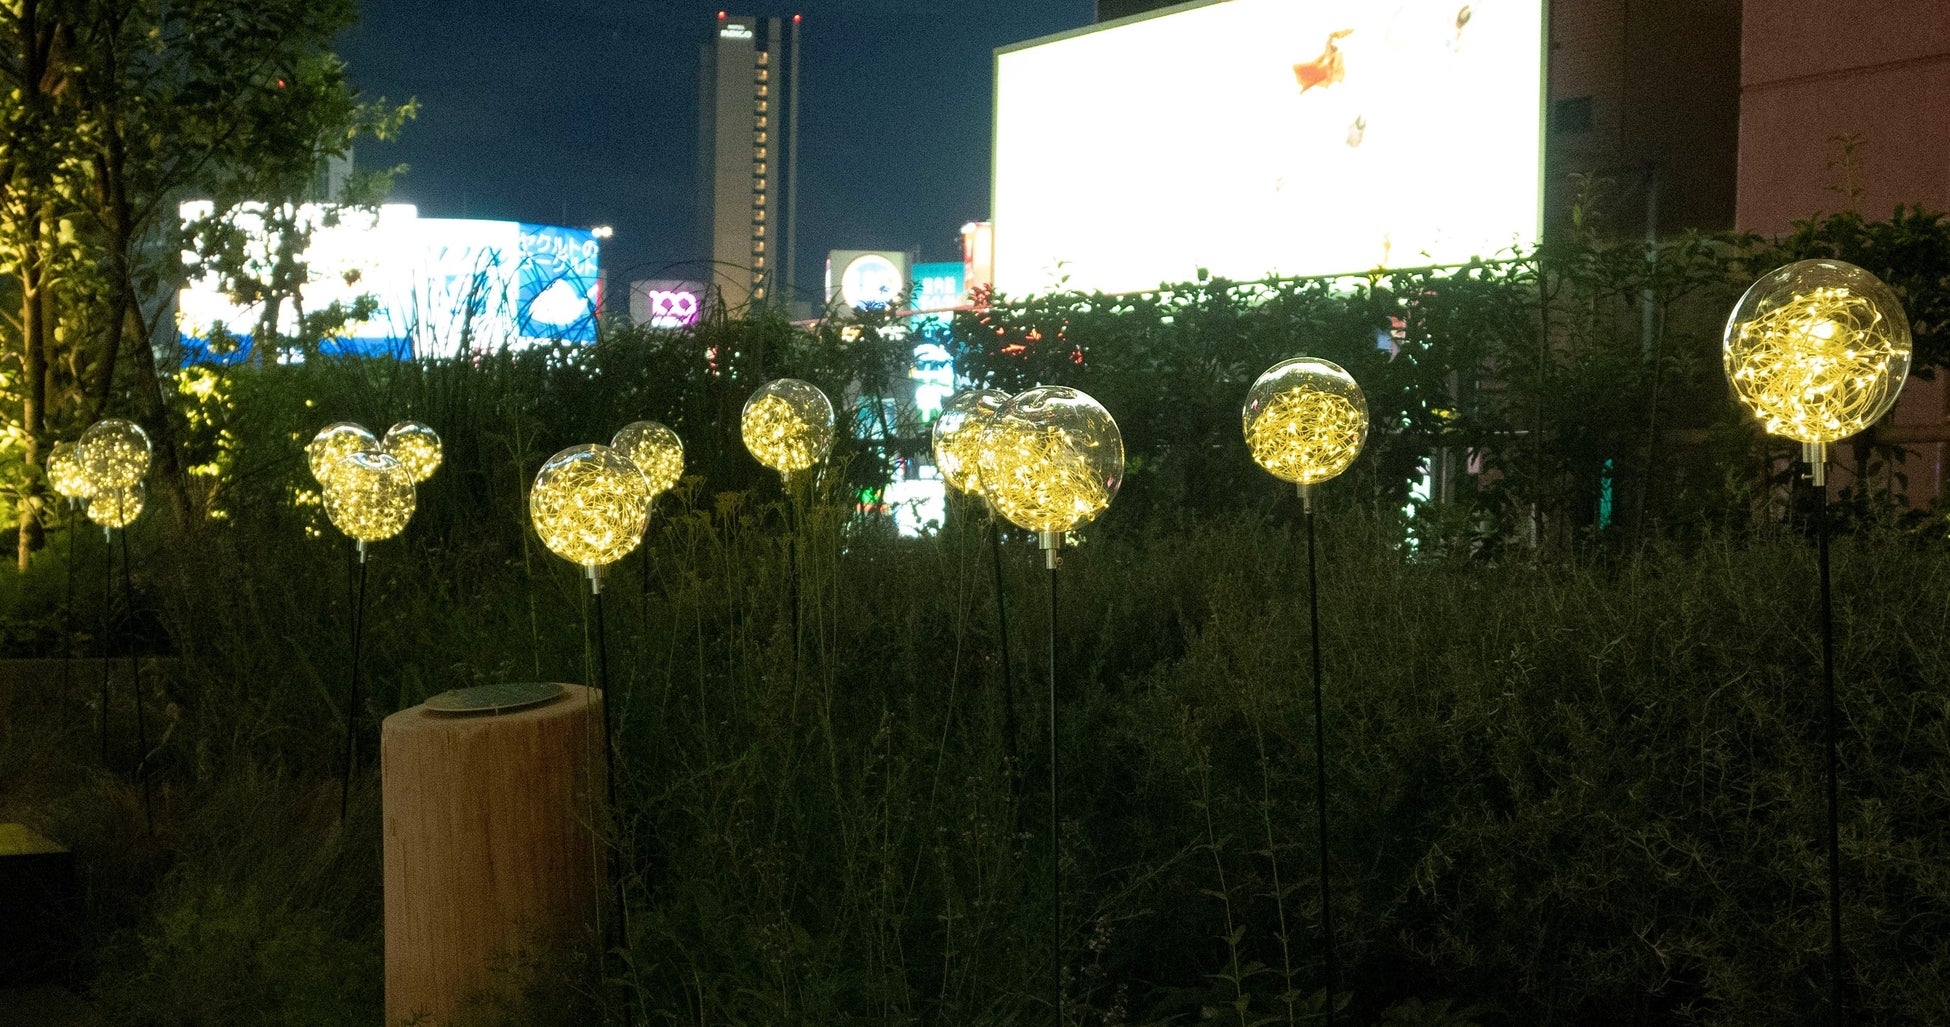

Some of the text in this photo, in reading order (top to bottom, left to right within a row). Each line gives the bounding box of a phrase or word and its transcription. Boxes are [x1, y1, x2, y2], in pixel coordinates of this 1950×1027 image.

[519, 232, 599, 258] ヤクルトの
